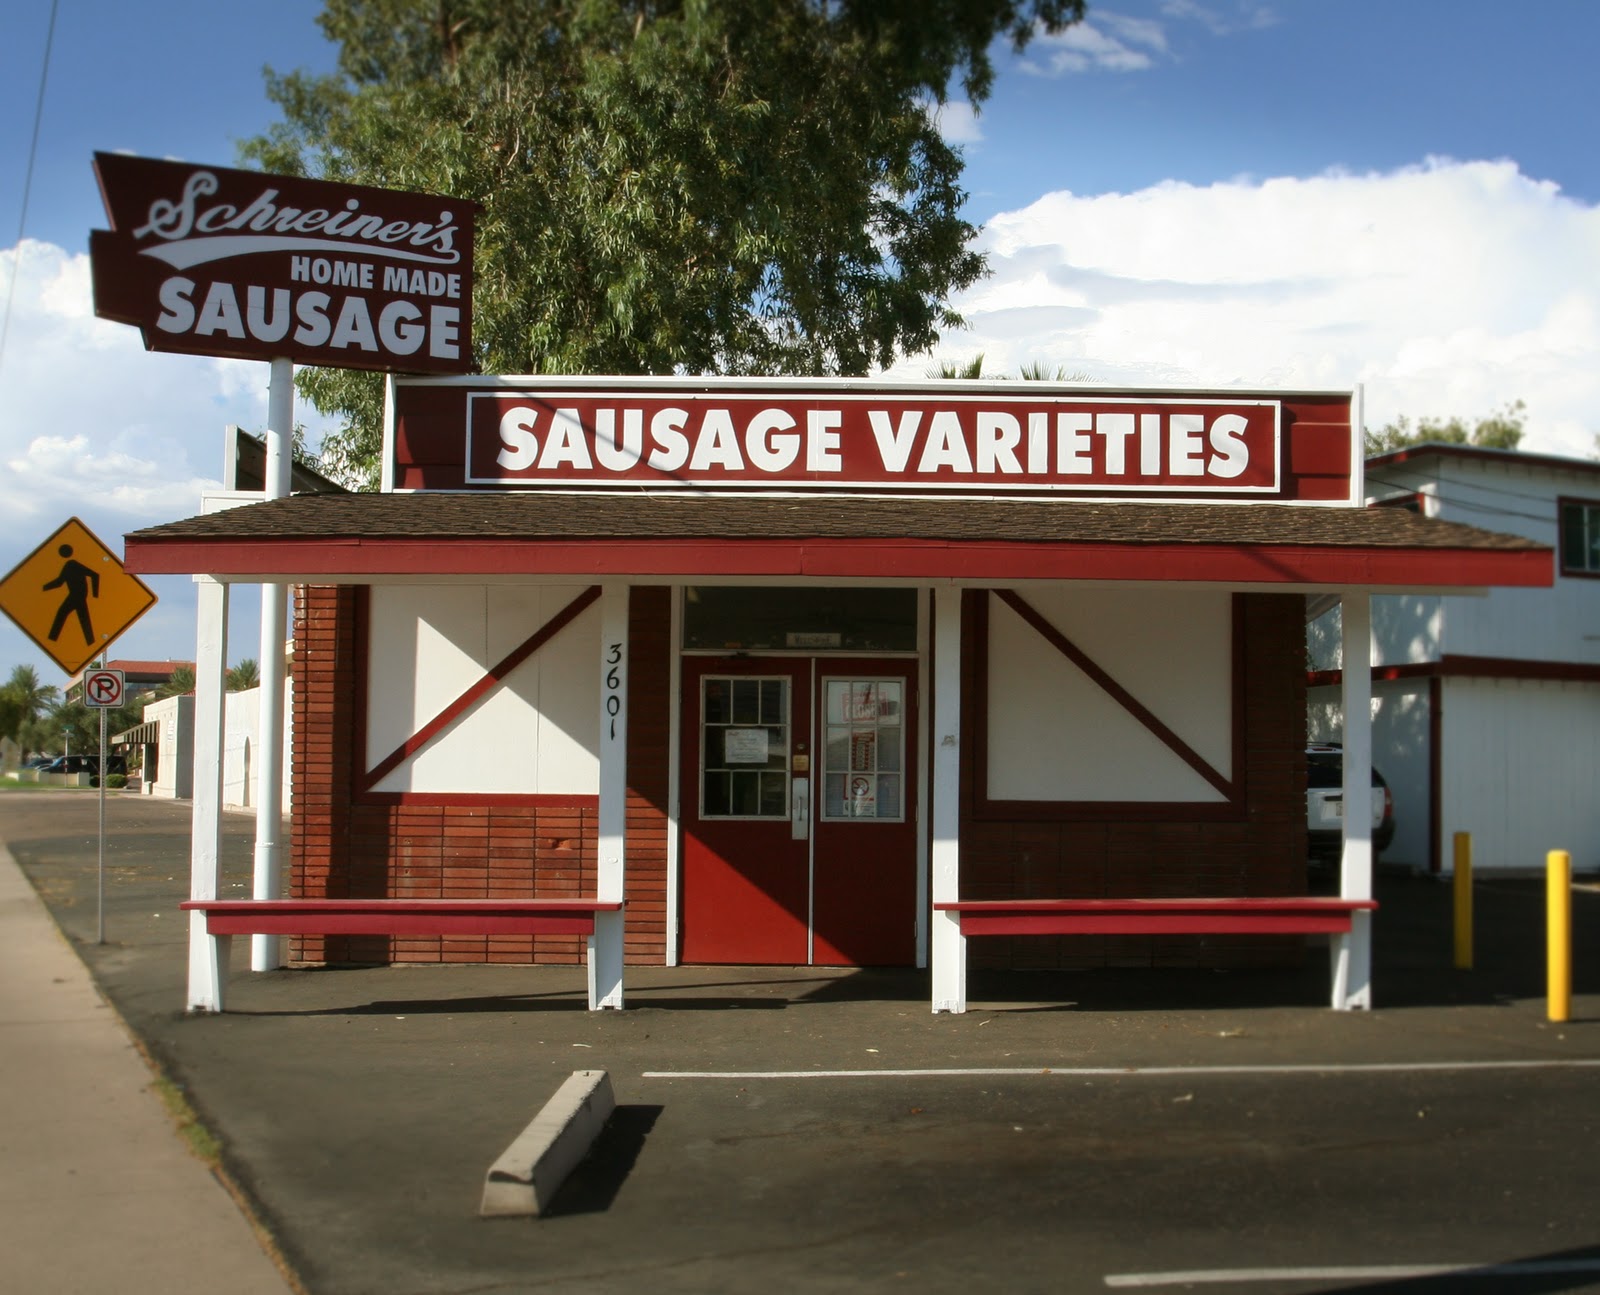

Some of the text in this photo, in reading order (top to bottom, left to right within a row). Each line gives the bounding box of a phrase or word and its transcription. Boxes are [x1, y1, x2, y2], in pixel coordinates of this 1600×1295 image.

[133, 171, 460, 255] Schreiner's
[156, 276, 461, 360] SAUSAGE
[291, 255, 461, 298] HOME MADE
[496, 406, 1249, 479] SAUSAGE VARIETIES
[606, 642, 622, 741] 3601
